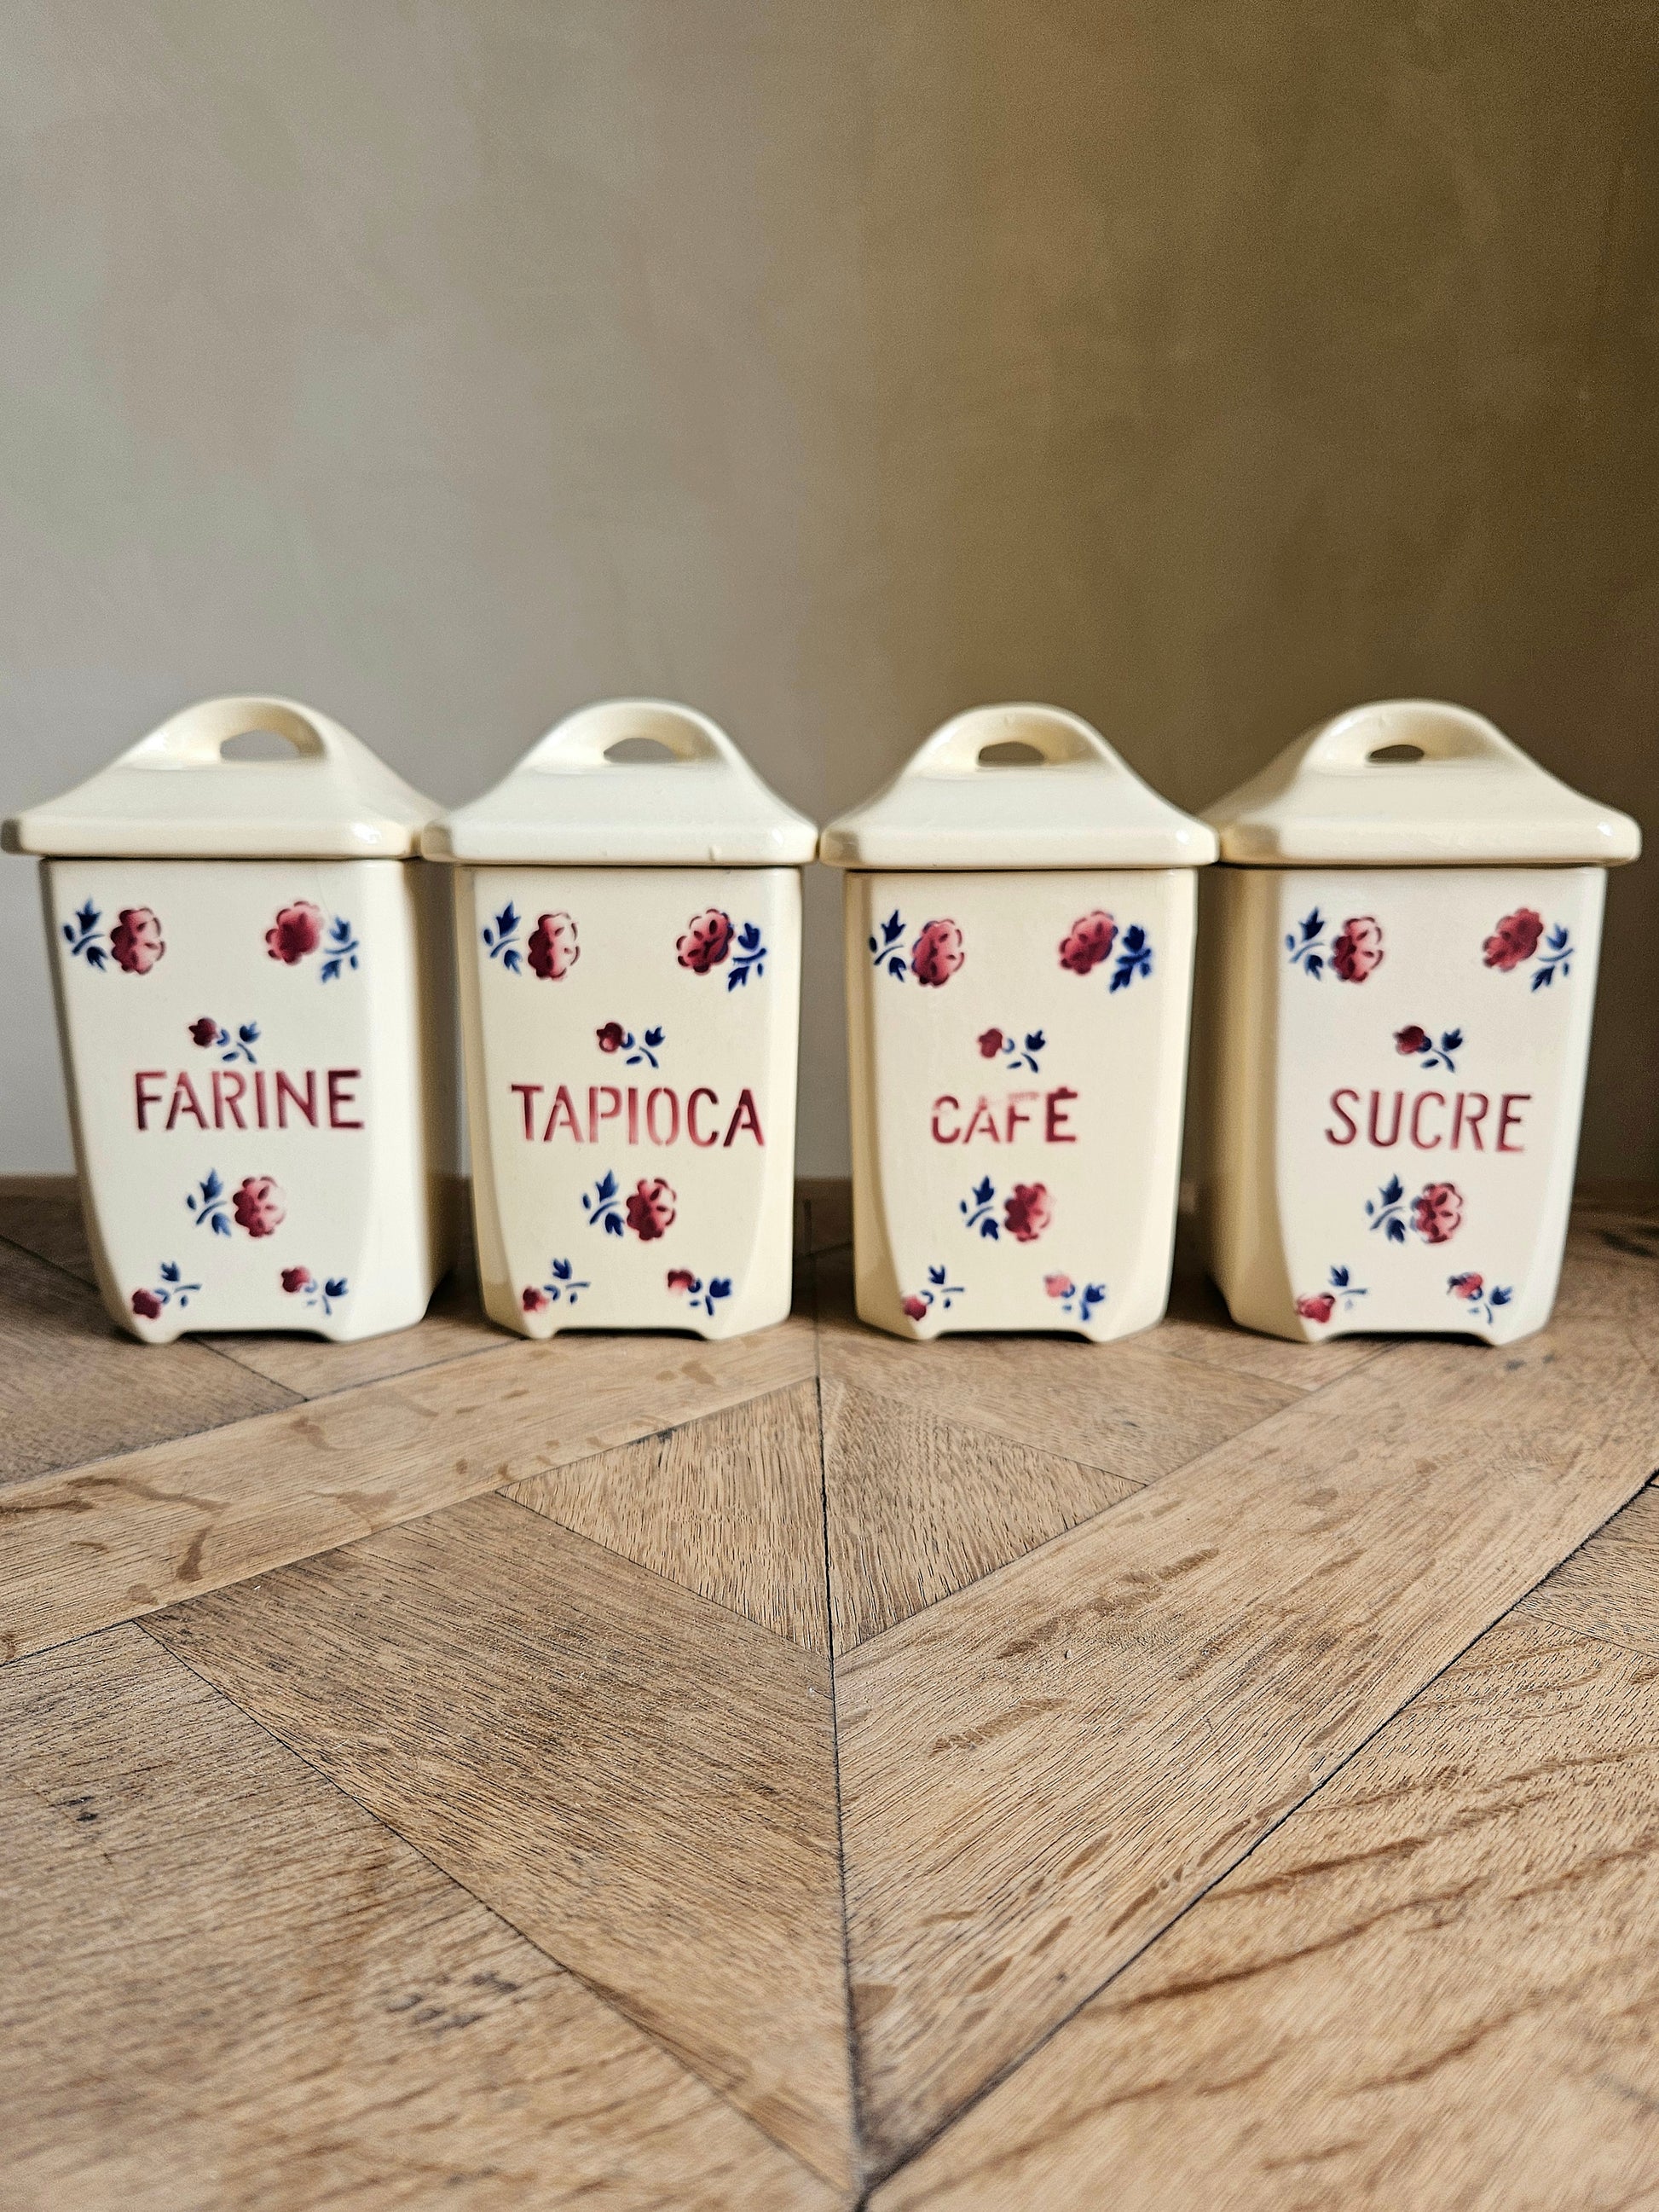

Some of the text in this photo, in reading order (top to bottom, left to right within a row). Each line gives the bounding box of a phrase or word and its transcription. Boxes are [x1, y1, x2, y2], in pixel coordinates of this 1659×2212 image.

[135, 1069, 364, 1131] FARINE
[511, 1084, 766, 1148] TAPIOCA
[1326, 1088, 1532, 1153] SUCRE
